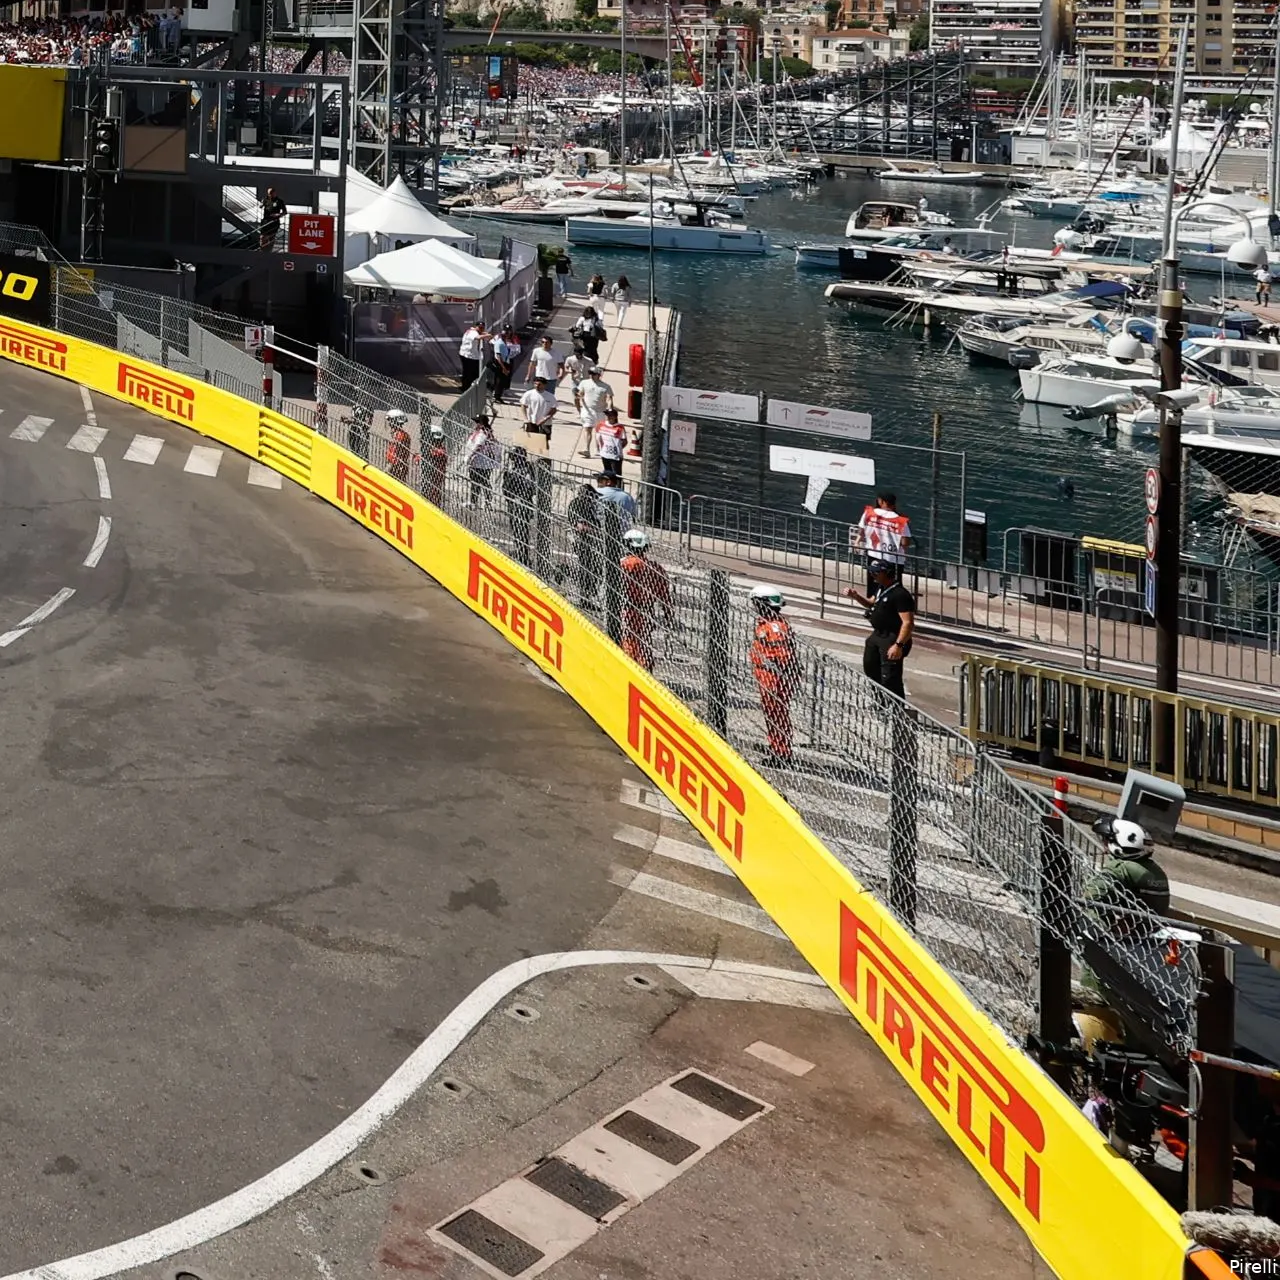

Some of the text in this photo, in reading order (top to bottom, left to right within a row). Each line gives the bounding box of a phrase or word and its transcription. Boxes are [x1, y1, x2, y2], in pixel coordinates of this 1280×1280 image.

[299, 229, 324, 237] LANE
[117, 362, 195, 422] PIRELLI
[336, 460, 414, 551] PIRELLI
[467, 549, 564, 672] PIRELLI
[627, 682, 746, 862] PIRELLI
[839, 900, 1046, 1222] PIRELLI
